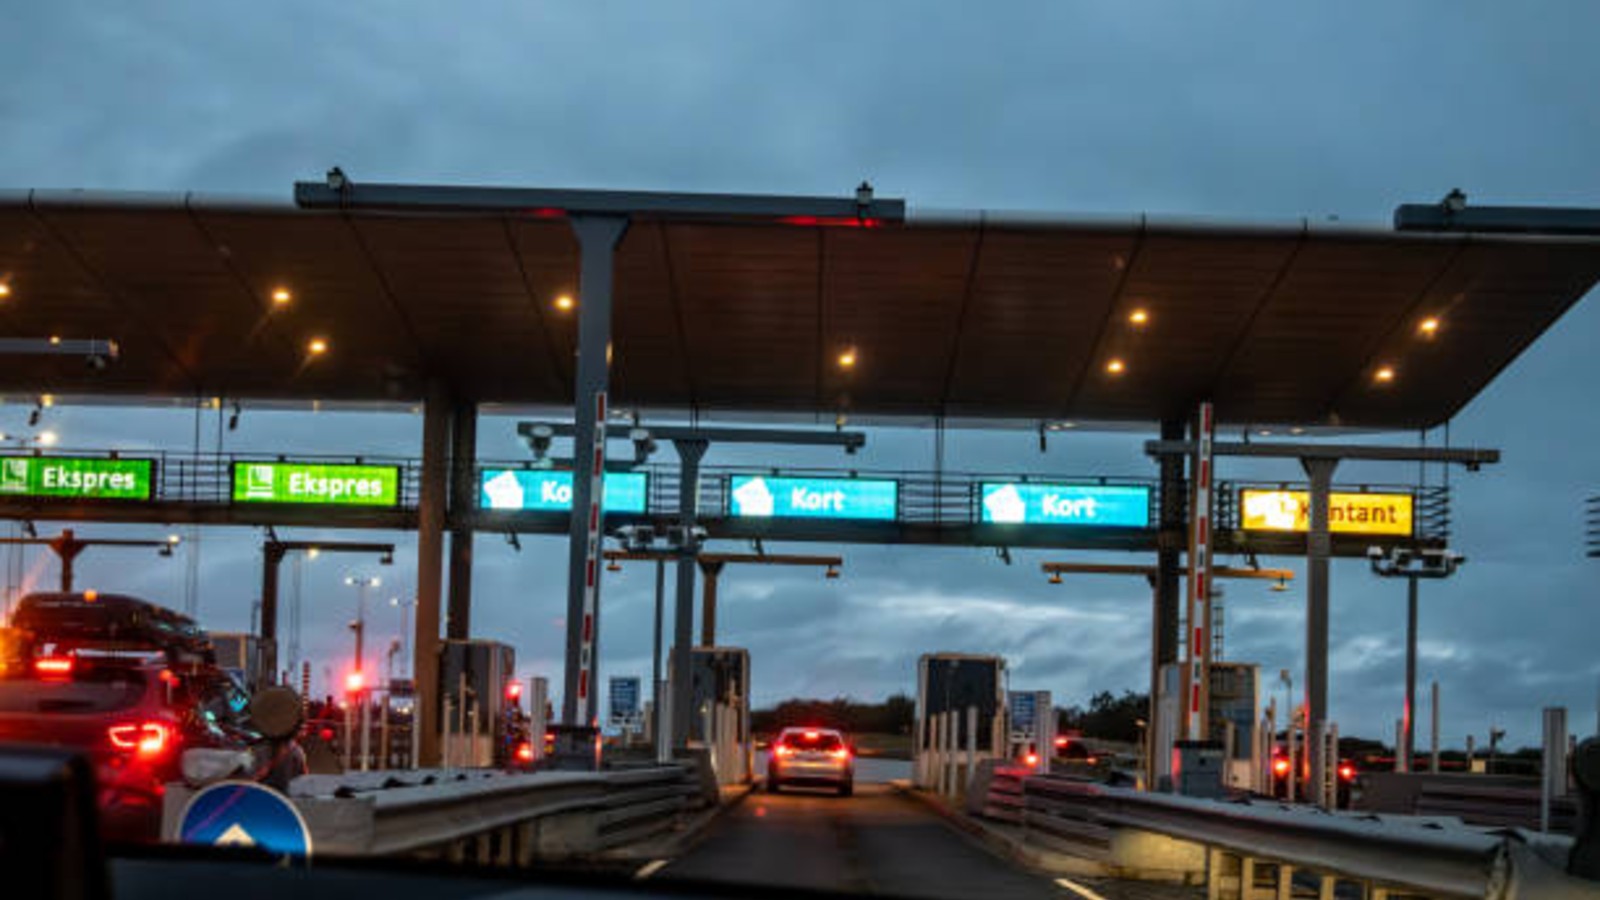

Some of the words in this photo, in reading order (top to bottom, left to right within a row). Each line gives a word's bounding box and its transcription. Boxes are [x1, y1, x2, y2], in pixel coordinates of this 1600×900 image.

[43, 465, 135, 494] Ekspres
[289, 471, 382, 499] Ekspres
[541, 480, 571, 503] Ko
[791, 487, 845, 511] Kort
[1042, 494, 1096, 518] Kort
[1300, 502, 1397, 524] Kntant
